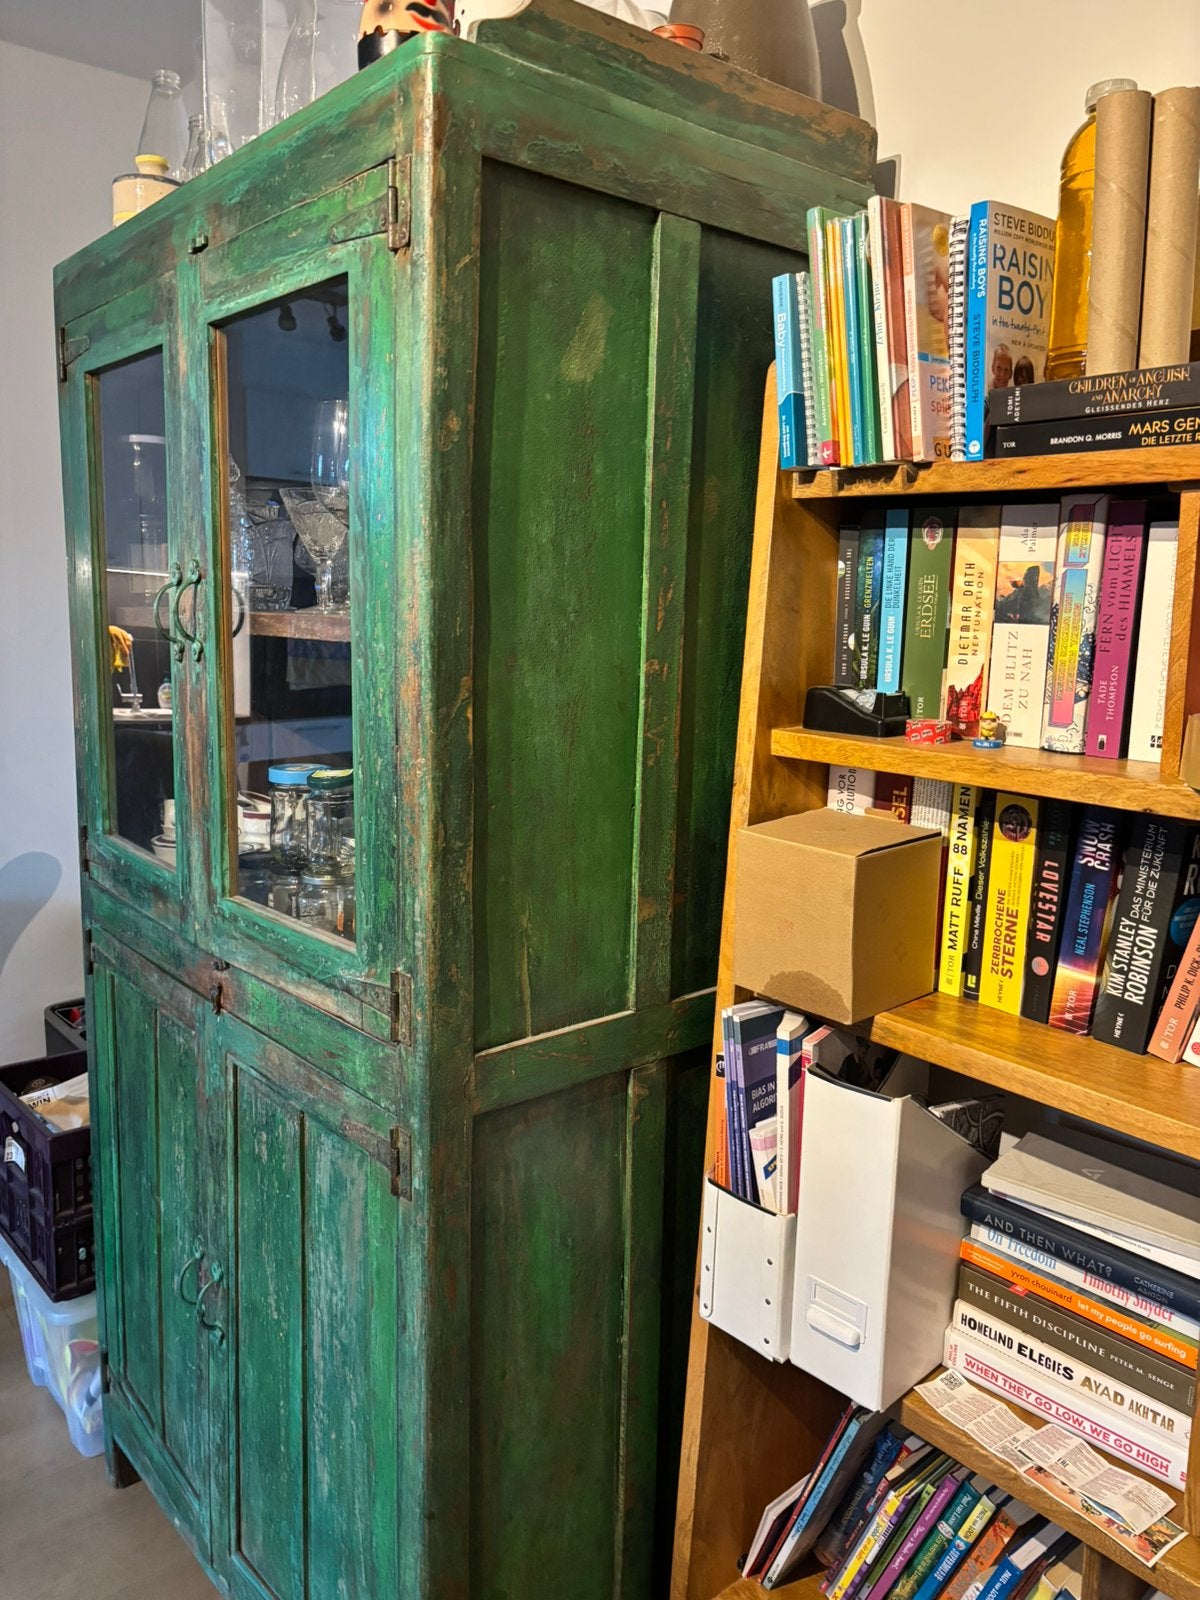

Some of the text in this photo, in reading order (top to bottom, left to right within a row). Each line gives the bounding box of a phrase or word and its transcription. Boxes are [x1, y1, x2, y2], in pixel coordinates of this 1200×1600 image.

[994, 212, 1055, 242] STEVE BIDDU
[977, 219, 987, 298] RAISING BOYS
[993, 243, 1055, 283] RAISIN
[777, 312, 788, 349] Baby
[972, 314, 981, 403] STEVE BIDDULPH
[1068, 372, 1127, 395] CHILDREN
[1134, 366, 1191, 387] ANGUISH
[1085, 399, 1170, 414] GLEISSENDES HERZ
[1102, 384, 1163, 404] ANARCHY
[1003, 441, 1016, 449] TOR
[1050, 431, 1122, 446] BRANDON Q. MORRIS
[1128, 416, 1200, 436] MARS GEN
[1141, 434, 1191, 446] DIE LETZTE
[1021, 528, 1029, 545] Ada
[1028, 521, 1038, 553] Palmer
[864, 556, 874, 608] GRENZWELTEN
[884, 537, 896, 609] DIE LINKE HAND DER
[891, 565, 902, 609] DUNKELHEIT
[1100, 523, 1124, 654] FERN vom LICHT
[1115, 534, 1137, 641] des HIMMELS
[920, 574, 936, 638] ERDSEE
[958, 562, 976, 666] DIETMAR DATH
[971, 571, 984, 656] NEPTUNATION
[860, 614, 871, 680] URSULA K. LE GUIN
[884, 615, 895, 683] URSULA K. LE GUIN
[1006, 631, 1019, 681] BLITZ
[1018, 648, 1033, 709] ZU NAH
[1098, 680, 1108, 704] TADE
[1106, 665, 1120, 721] THOMPSON
[960, 699, 968, 718] TOR
[1002, 685, 1014, 724] DEM
[838, 773, 847, 797] VOR
[957, 786, 971, 841] NAMEN
[975, 817, 990, 900] Dieser Volkszähler
[1078, 820, 1100, 867] SNOW
[1094, 823, 1115, 871] CRASH
[1130, 823, 1157, 919] DAS MINISTERIUM
[1141, 826, 1168, 923] FÜR DIE ZUKUNFT
[948, 866, 964, 951] MATT RUFF
[1035, 860, 1059, 943] LOVESTAR
[1075, 883, 1096, 955] NEAL STEPHENSON
[971, 927, 980, 950] China
[991, 888, 1006, 975] ZERBROCHENE
[1000, 907, 1019, 980] STERNE
[1106, 917, 1137, 997] KIM STANLEY
[1124, 924, 1158, 1005] ROBINSON
[1067, 989, 1077, 1011] TOR
[1174, 958, 1200, 1011] PHILIP K. DICK
[1114, 1016, 1124, 1038] HEYNE
[1164, 1017, 1179, 1037] TOR
[751, 1082, 776, 1100] BIAS IN
[984, 1214, 1014, 1233] AND
[1019, 1228, 1056, 1253] THEN
[1062, 1247, 1113, 1277] WHAT?
[986, 1228, 1003, 1243] On
[1007, 1235, 1057, 1270] Freedom
[1011, 1269, 1072, 1304] yvon chouinard
[1082, 1269, 1175, 1322] Timothy Snyder
[1134, 1276, 1174, 1299] CATHERINE
[967, 1282, 1106, 1358] THE FIFTH DISCIPLINE
[1077, 1300, 1187, 1360] let my people go surfing
[960, 1312, 1074, 1381] HOMELAND ELEGIES
[1110, 1353, 1175, 1391] PETER M. SENGE
[965, 1357, 1169, 1473] WHEN THEY GO LOW, WE GO HIGH
[1080, 1376, 1175, 1433] AYAD AKHTAR
[948, 1512, 961, 1526] Loon
[961, 1493, 973, 1508] Paul
[979, 1507, 988, 1521] PAUL
[964, 1524, 976, 1540] LOON
[1001, 1569, 1012, 1585] PAUL
